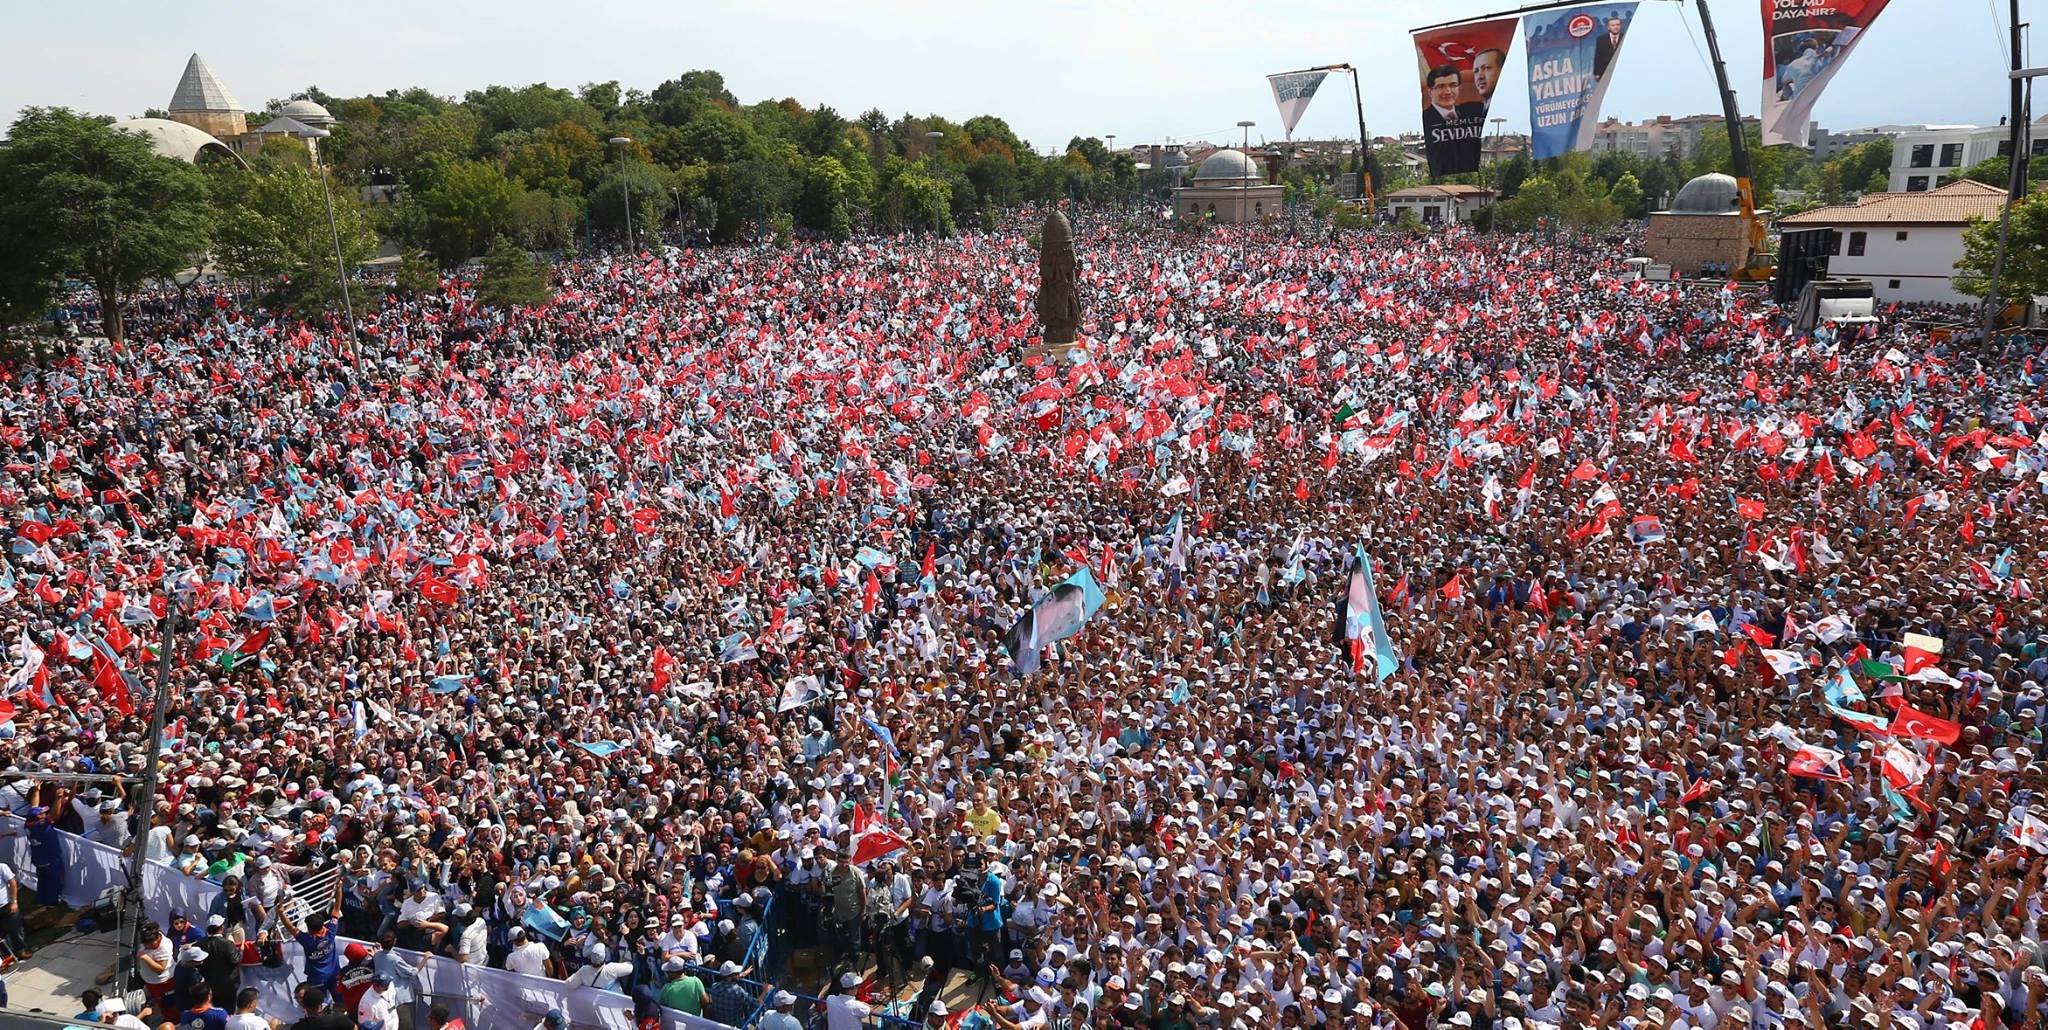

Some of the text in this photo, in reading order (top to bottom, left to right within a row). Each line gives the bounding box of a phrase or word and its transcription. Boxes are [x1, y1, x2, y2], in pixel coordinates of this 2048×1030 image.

[1772, 7, 1836, 20] DAYANIR?
[1532, 57, 1573, 82] ASLA
[1537, 112, 1567, 127] UZUN
